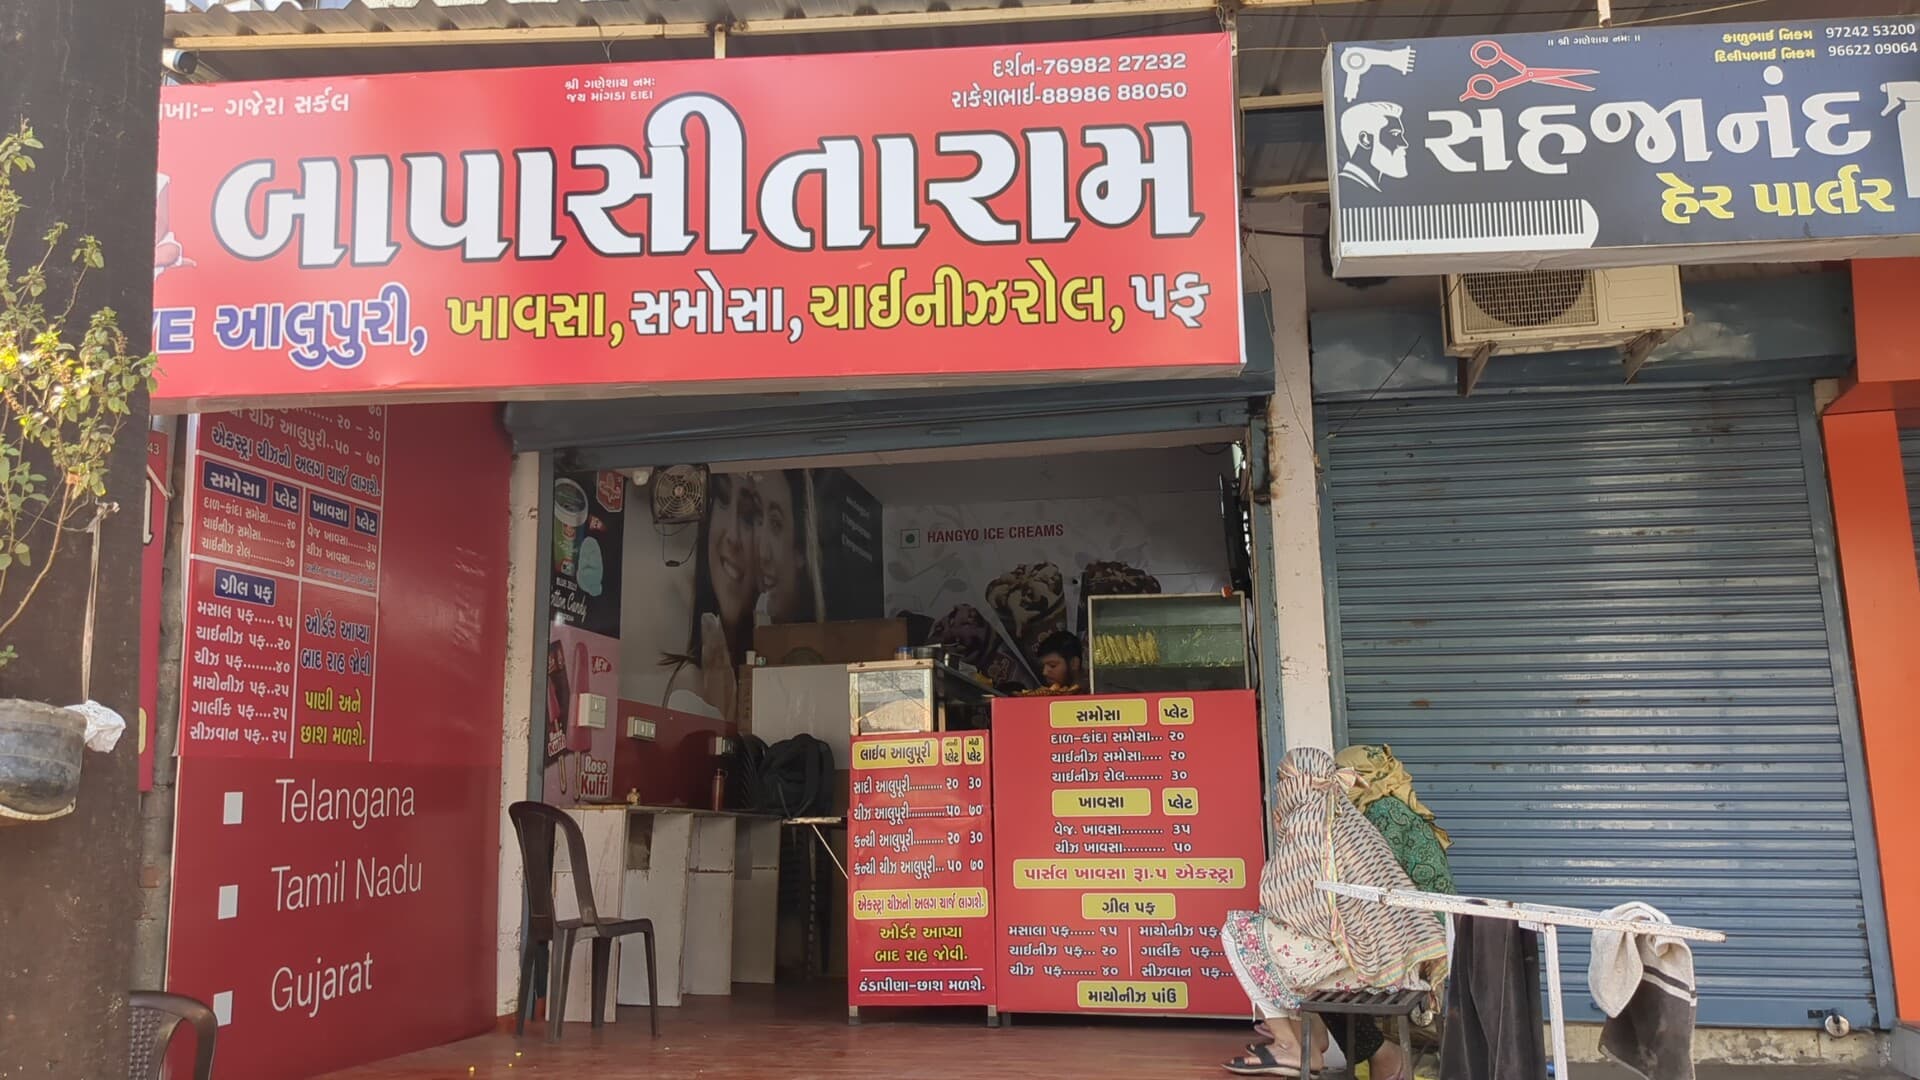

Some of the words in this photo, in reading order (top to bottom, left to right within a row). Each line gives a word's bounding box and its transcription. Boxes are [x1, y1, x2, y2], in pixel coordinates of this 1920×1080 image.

[1778, 28, 1813, 42] નિકમ
[1826, 26, 1869, 38] 97242
[1872, 24, 1916, 36] 53200
[1780, 48, 1815, 60] નિકમ
[1828, 45, 1871, 57] 96622
[1875, 42, 1918, 54] 09064
[1118, 52, 1187, 74] 27232
[224, 90, 284, 116] ગજેરા
[294, 86, 349, 113] સર્કલ
[631, 91, 653, 100] દાદા
[1117, 82, 1187, 102] 88050
[1424, 66, 1872, 174] સહજાનંદ
[211, 91, 1206, 269] બાપાસીતારામ
[1656, 172, 1734, 224] હેર
[1750, 164, 1896, 217] પાર્લર
[1131, 270, 1211, 329] પફ
[209, 469, 261, 499] સમોસા
[274, 488, 298, 510] પ્લેટ
[311, 498, 348, 522] ખાવસા
[355, 510, 376, 533] પ્લેટ
[927, 528, 978, 544] HANGYO
[983, 526, 1006, 542] ICE
[1008, 524, 1064, 539] CREAMS
[305, 686, 333, 712] પાણી
[1076, 705, 1121, 722] સમોસા
[1164, 704, 1189, 719] પ્લેટ
[585, 756, 607, 774] Rose
[581, 774, 608, 796] Kulfi
[276, 778, 415, 830] Telangana
[1078, 795, 1124, 809] ખાવસા
[1167, 794, 1193, 809] પ્લેટ
[271, 860, 346, 912] Tamil
[355, 853, 422, 900] Nadu
[1075, 866, 1125, 880] ખાવસા
[1101, 898, 1130, 914] ગ્રીલ
[1135, 901, 1155, 914] પફ
[1008, 925, 1045, 936] મસાલા
[905, 950, 928, 962] રાહ
[271, 952, 373, 1018] Gujarat
